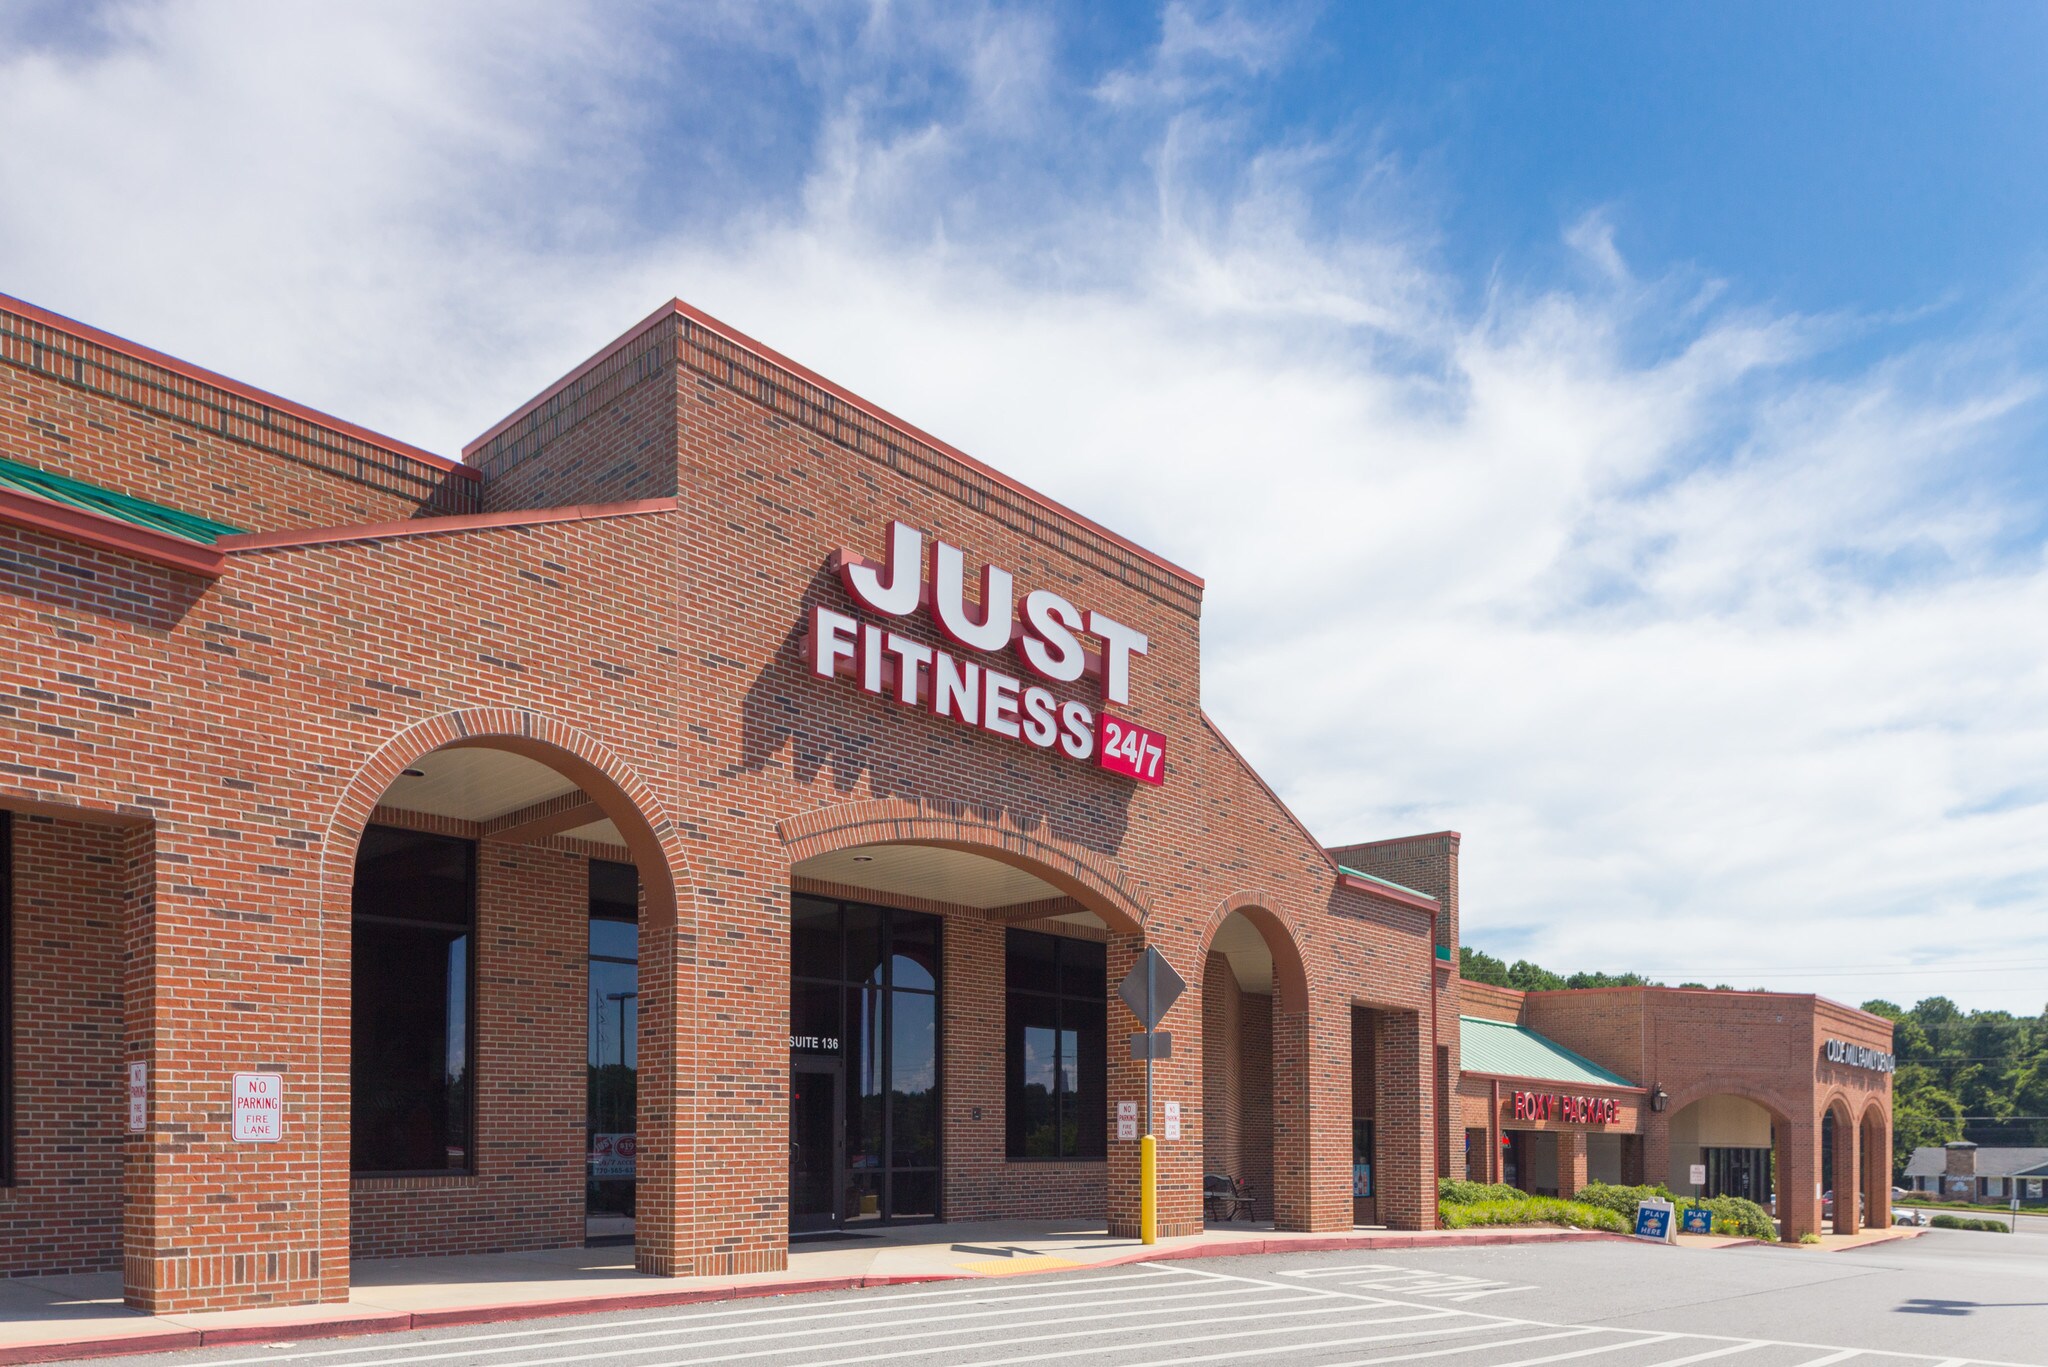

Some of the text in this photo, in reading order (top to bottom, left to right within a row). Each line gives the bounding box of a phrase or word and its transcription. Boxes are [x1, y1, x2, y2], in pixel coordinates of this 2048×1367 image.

[841, 520, 1148, 706] JUST
[809, 605, 1094, 760] FITNESS
[1105, 722, 1163, 778] 24/7
[789, 1036, 839, 1049] SUITE 136
[1827, 1038, 1896, 1075] OLDE MILL FAMILY DENTAL
[249, 1081, 267, 1093] NO
[237, 1097, 278, 1109] PARKING
[1123, 1105, 1132, 1113] NO
[1512, 1091, 1621, 1124] ROXY PACKAGE
[246, 1115, 268, 1123] FIRE
[243, 1126, 270, 1134] LANE
[1644, 1210, 1665, 1218] PLAY
[1640, 1227, 1661, 1236] HERE
